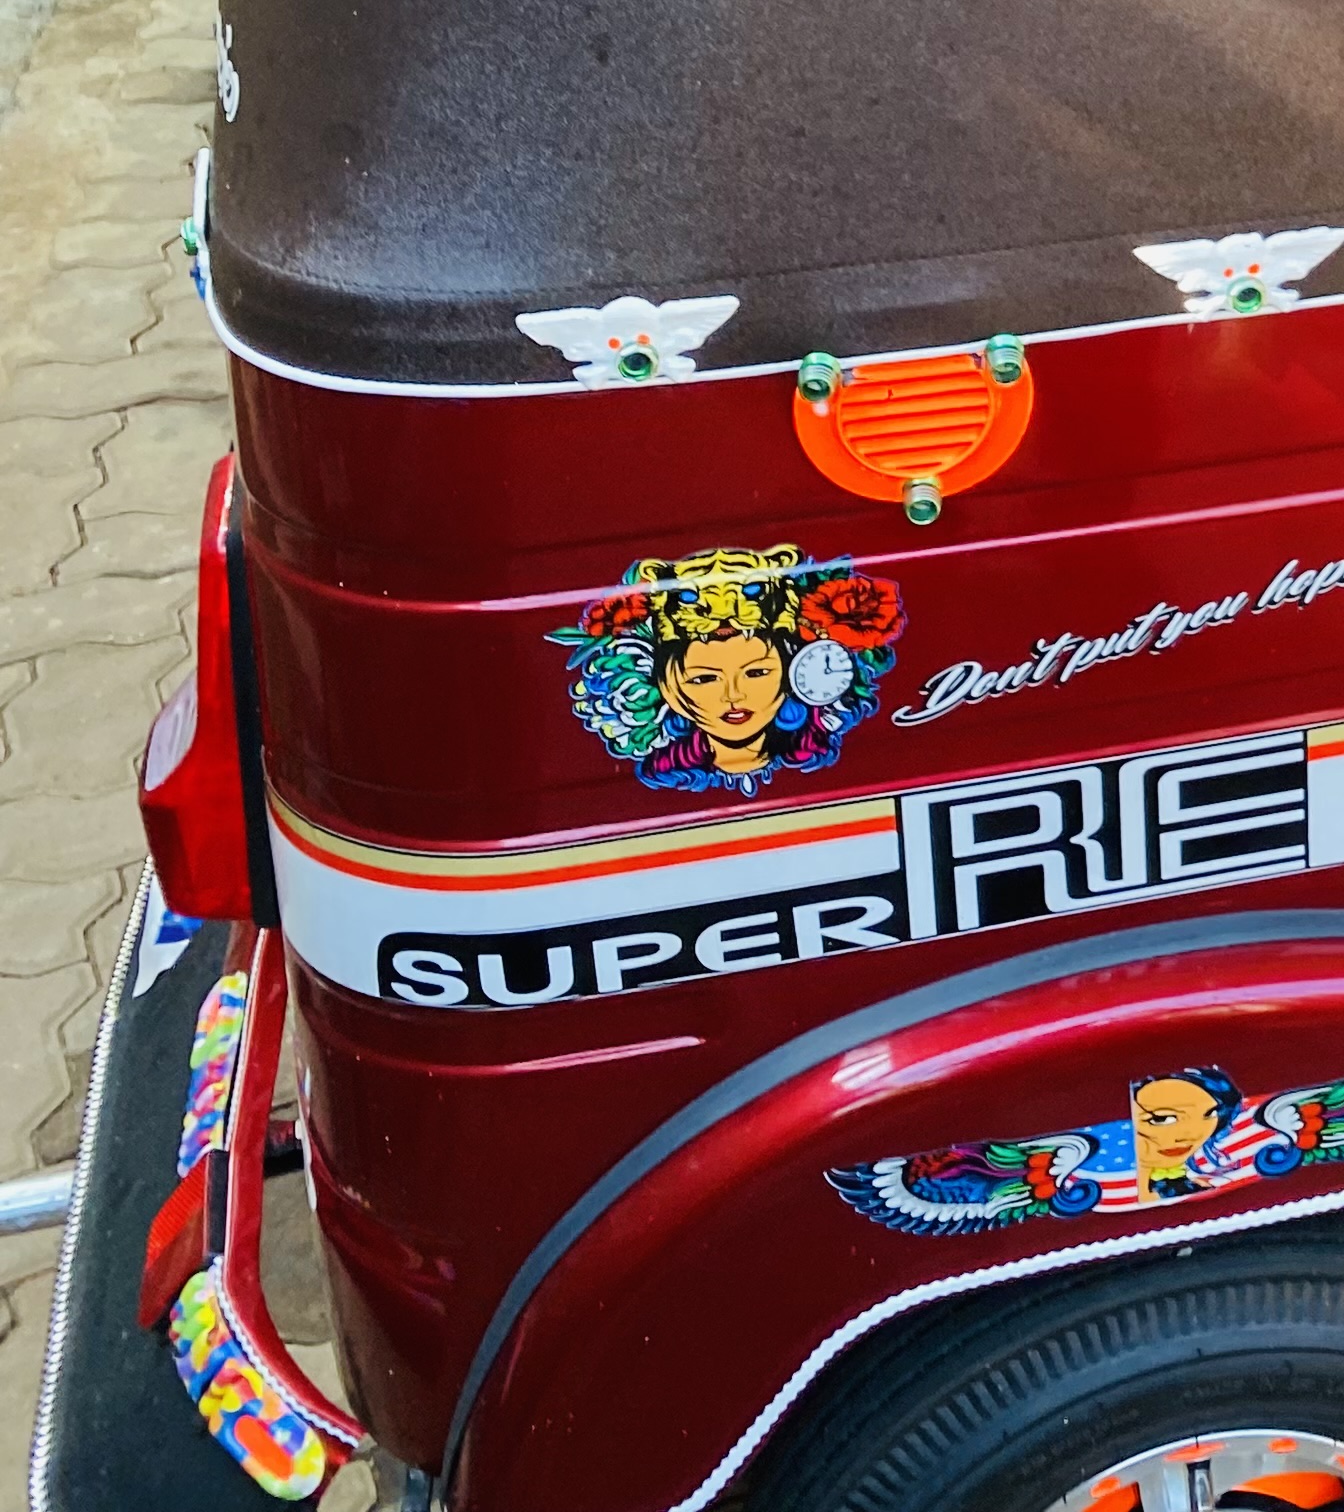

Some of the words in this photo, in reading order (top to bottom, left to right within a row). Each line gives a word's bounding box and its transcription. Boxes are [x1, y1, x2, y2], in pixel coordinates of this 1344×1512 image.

[891, 632, 1084, 727] Don't
[1053, 601, 1181, 688] put
[1148, 591, 1250, 655] you
[390, 893, 908, 1009] SUPER
[906, 726, 1307, 941] RE
